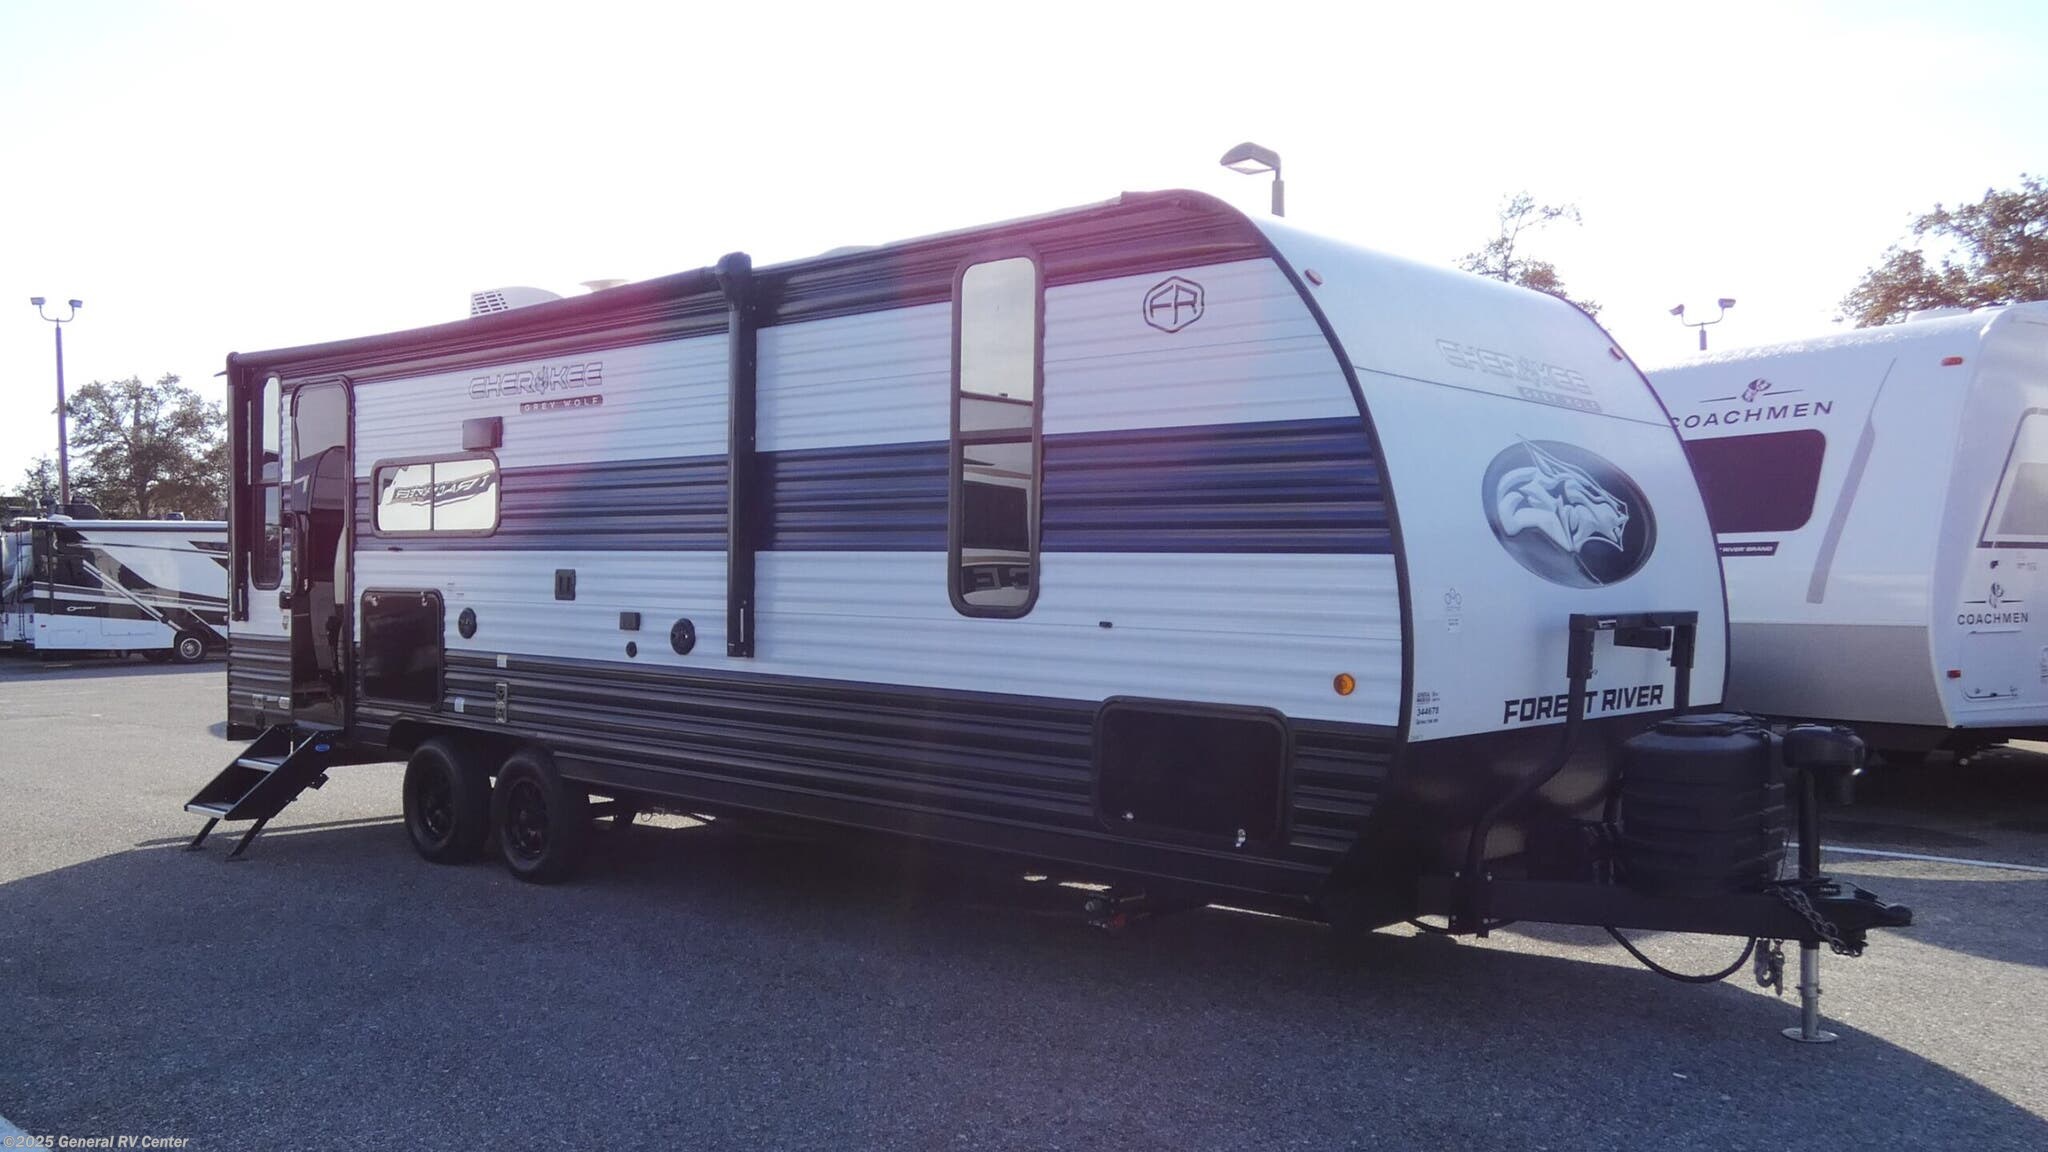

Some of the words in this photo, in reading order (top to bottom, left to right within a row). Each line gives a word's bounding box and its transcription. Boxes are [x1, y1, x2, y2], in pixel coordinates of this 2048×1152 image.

[469, 362, 603, 400] CHEROKEE
[524, 402, 555, 412] GREY
[564, 397, 599, 408] WOLF
[1957, 612, 2029, 625] COACHMEN
[1503, 690, 1598, 724] FORET
[1601, 684, 1664, 712] RIVER
